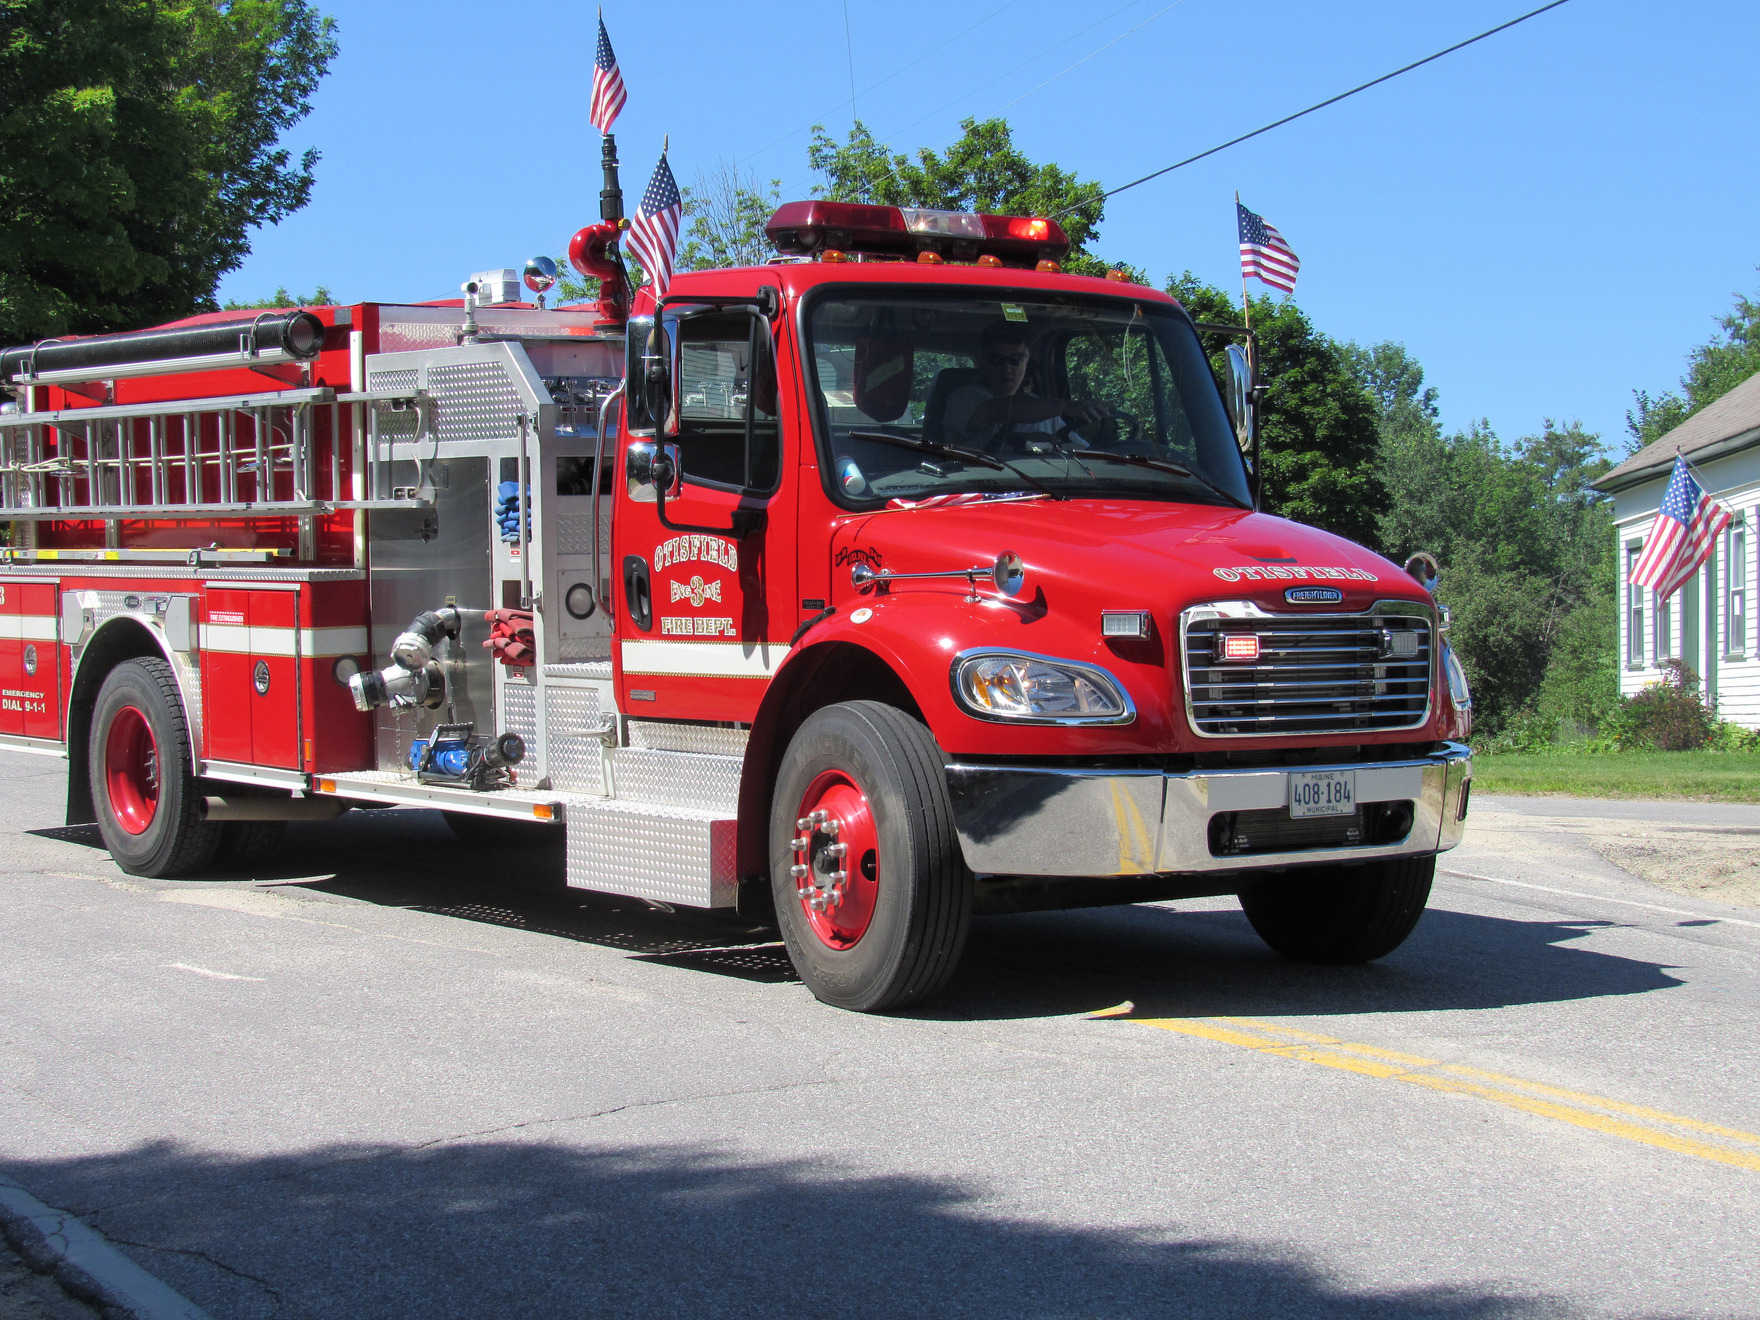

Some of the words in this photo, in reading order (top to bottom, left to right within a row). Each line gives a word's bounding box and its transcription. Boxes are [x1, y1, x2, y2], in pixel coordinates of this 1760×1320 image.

[654, 534, 738, 572] OTISFIELD
[1212, 565, 1379, 582] OTISFIELD
[1292, 590, 1338, 601] FREIGHTLINER
[209, 614, 218, 622] FIRE
[219, 614, 244, 623] EXTINGUISHER
[660, 617, 693, 635] FIRE
[694, 617, 736, 636] DEPT.
[2, 689, 45, 699] EMERGENCY
[2, 698, 23, 711] DIAL
[25, 700, 46, 714] 9-1-1
[795, 731, 889, 828] MICHELIN
[1311, 773, 1335, 781] MAINE
[1306, 805, 1339, 813] MUNICIPAL
